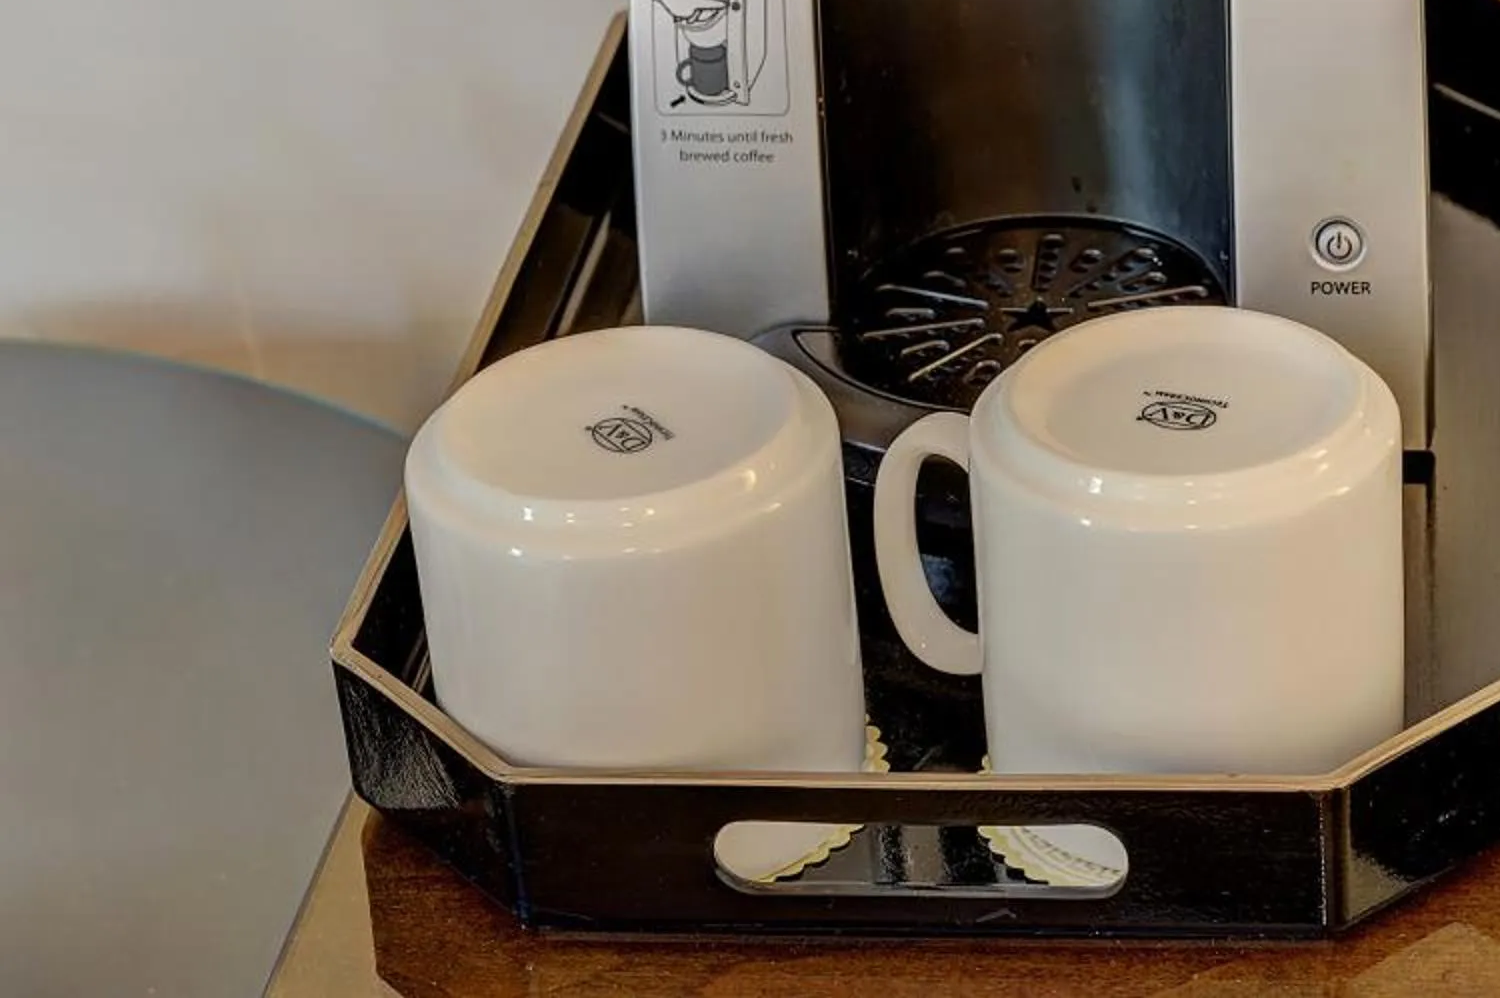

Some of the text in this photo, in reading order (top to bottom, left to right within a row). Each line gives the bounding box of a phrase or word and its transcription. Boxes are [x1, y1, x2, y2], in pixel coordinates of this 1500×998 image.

[671, 129, 725, 143] Minutes
[727, 129, 758, 143] until
[760, 129, 794, 143] fresh
[679, 149, 775, 163] brewed coffee
[1311, 281, 1371, 296] POWER
